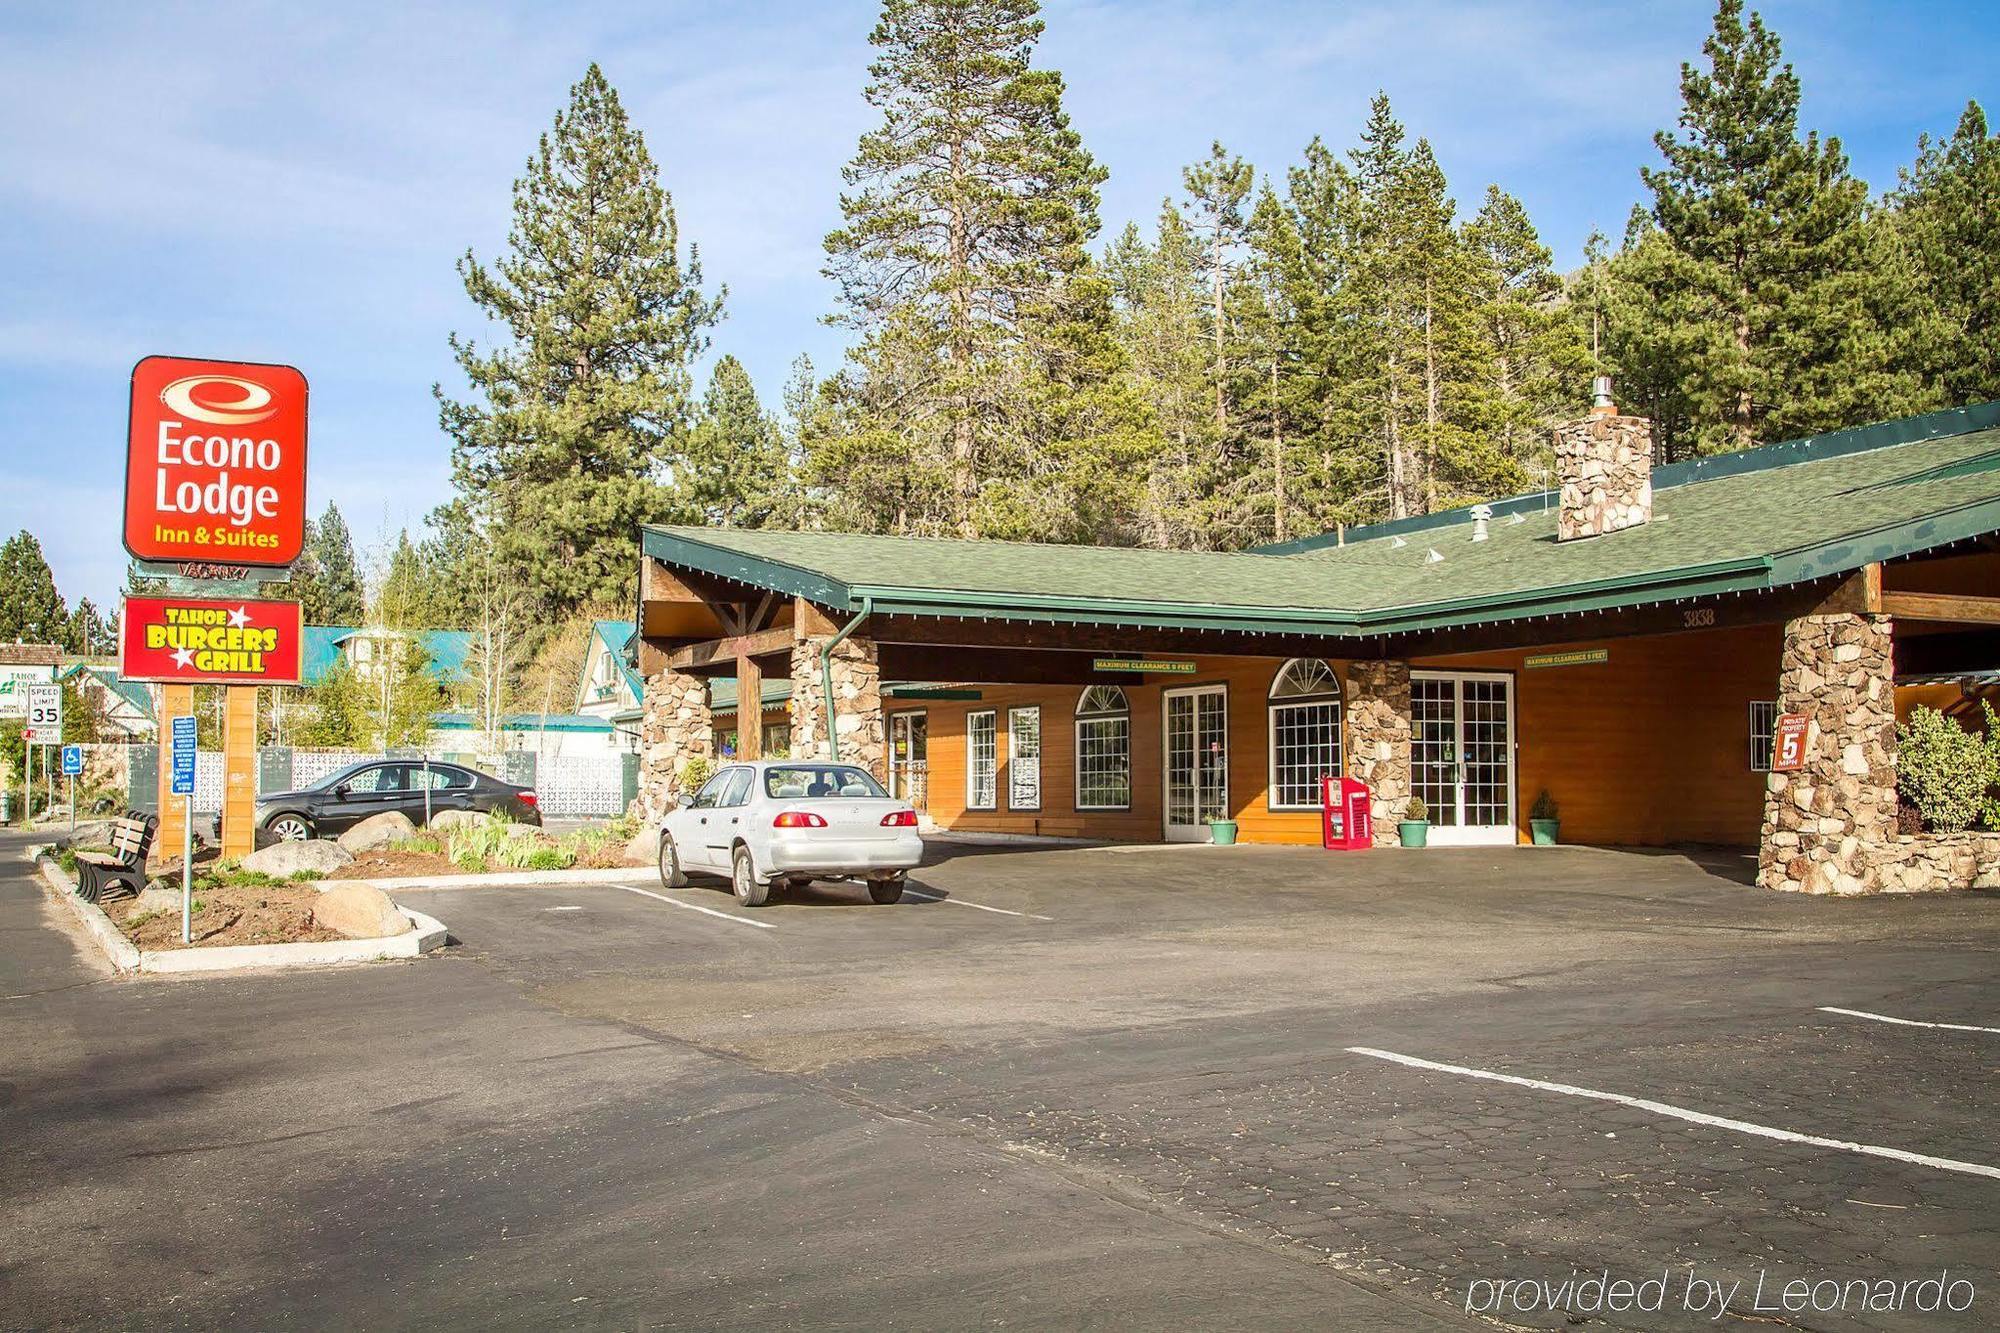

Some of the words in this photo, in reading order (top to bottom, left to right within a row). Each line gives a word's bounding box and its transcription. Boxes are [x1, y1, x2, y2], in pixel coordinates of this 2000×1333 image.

[157, 420, 281, 471] Econo
[155, 467, 279, 526] Lodge
[156, 524, 190, 545] Inn
[194, 526, 210, 545] &
[214, 527, 279, 548] Suites
[165, 608, 228, 625] TAHOE
[1683, 609, 1714, 628] 3838
[146, 624, 277, 652] BURGERS
[194, 650, 266, 673] GRILL
[1097, 661, 1130, 669] MAXIMUM
[1131, 662, 1169, 670] CLEARANCE
[1177, 663, 1194, 671] FEET
[31, 688, 59, 696] SPEED
[33, 698, 55, 706] LIMIT
[33, 708, 58, 723] 35
[1781, 732, 1800, 760] 5
[1778, 759, 1799, 767] MPH
